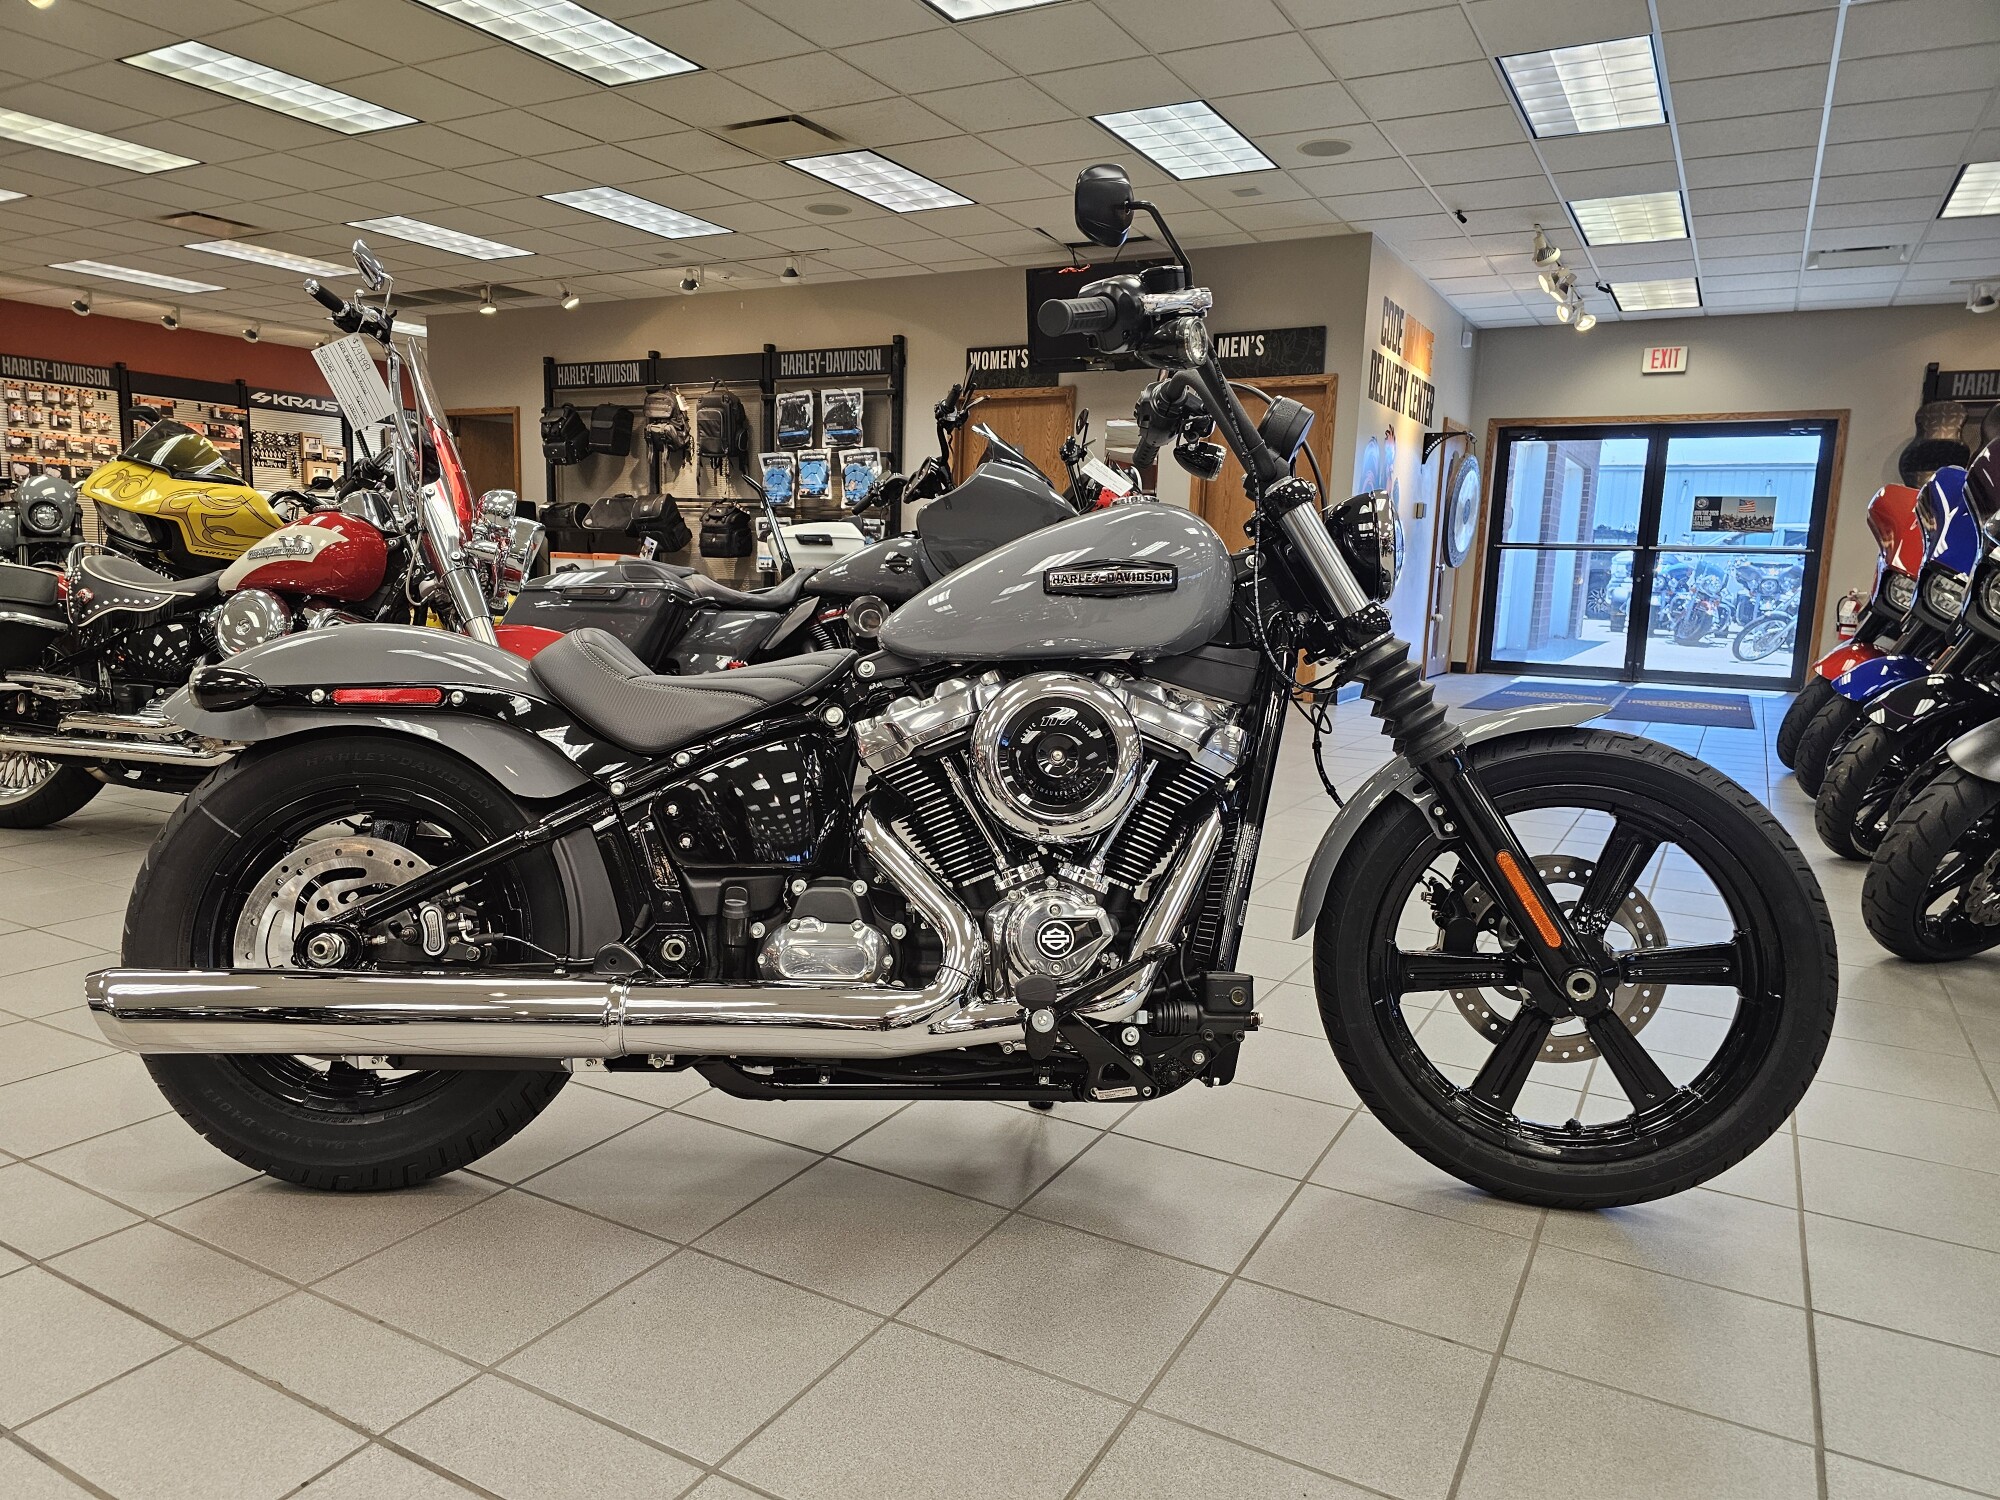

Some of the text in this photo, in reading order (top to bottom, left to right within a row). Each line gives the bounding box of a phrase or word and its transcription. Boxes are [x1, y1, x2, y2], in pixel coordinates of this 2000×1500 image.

[1381, 296, 1404, 356] CODE
[1218, 335, 1265, 358] MEN'S
[1651, 348, 1681, 369] EXIT
[2, 356, 110, 387] HARLEY-DAVIDSON
[781, 349, 881, 376] HARLEY-DAVIDSON
[970, 348, 1029, 371] WOMEN'S
[557, 362, 640, 386] HARLEY-DAVIDSON
[1952, 372, 2000, 396] HARL
[1368, 349, 1435, 428] DELIVERY CENTER
[273, 393, 339, 412] KRAUS
[1052, 572, 1170, 585] HARLEY-DAVIDSON
